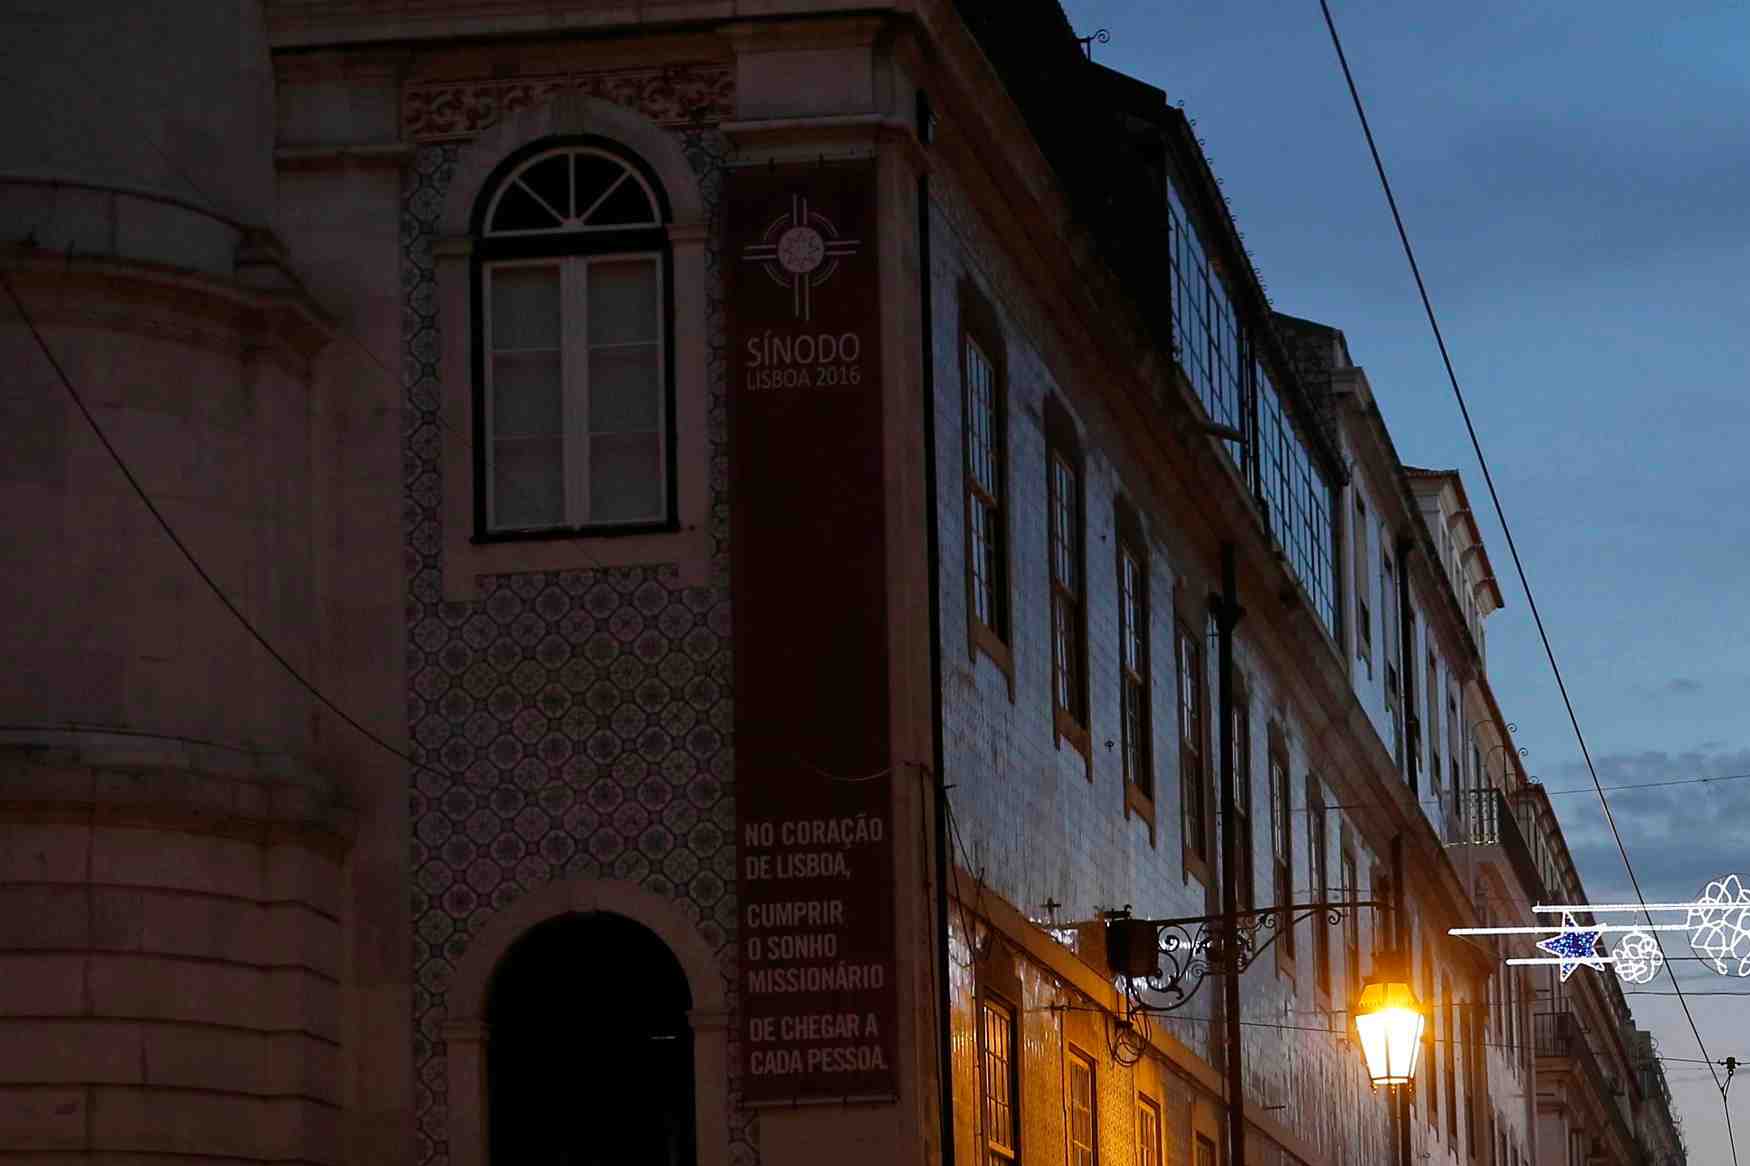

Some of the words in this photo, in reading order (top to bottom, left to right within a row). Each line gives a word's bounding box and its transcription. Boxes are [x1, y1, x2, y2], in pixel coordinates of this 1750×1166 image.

[747, 329, 861, 367] SÍNODO
[746, 368, 811, 391] LISBOA
[816, 366, 862, 386] 2016
[744, 822, 774, 847] NO
[781, 811, 884, 849] CORAÇÃO
[745, 855, 771, 880] DE
[776, 851, 852, 880] LISBOA,
[747, 899, 845, 928] CUMPRIR
[747, 936, 762, 961] O
[767, 933, 839, 960] SONHO
[749, 961, 886, 993] MISSIONÁRIO
[750, 1016, 776, 1042] DE
[781, 1012, 860, 1041] CHEGAR
[864, 1011, 879, 1039] A
[751, 1049, 804, 1076] CADA
[807, 1044, 889, 1074] PESSOA.
